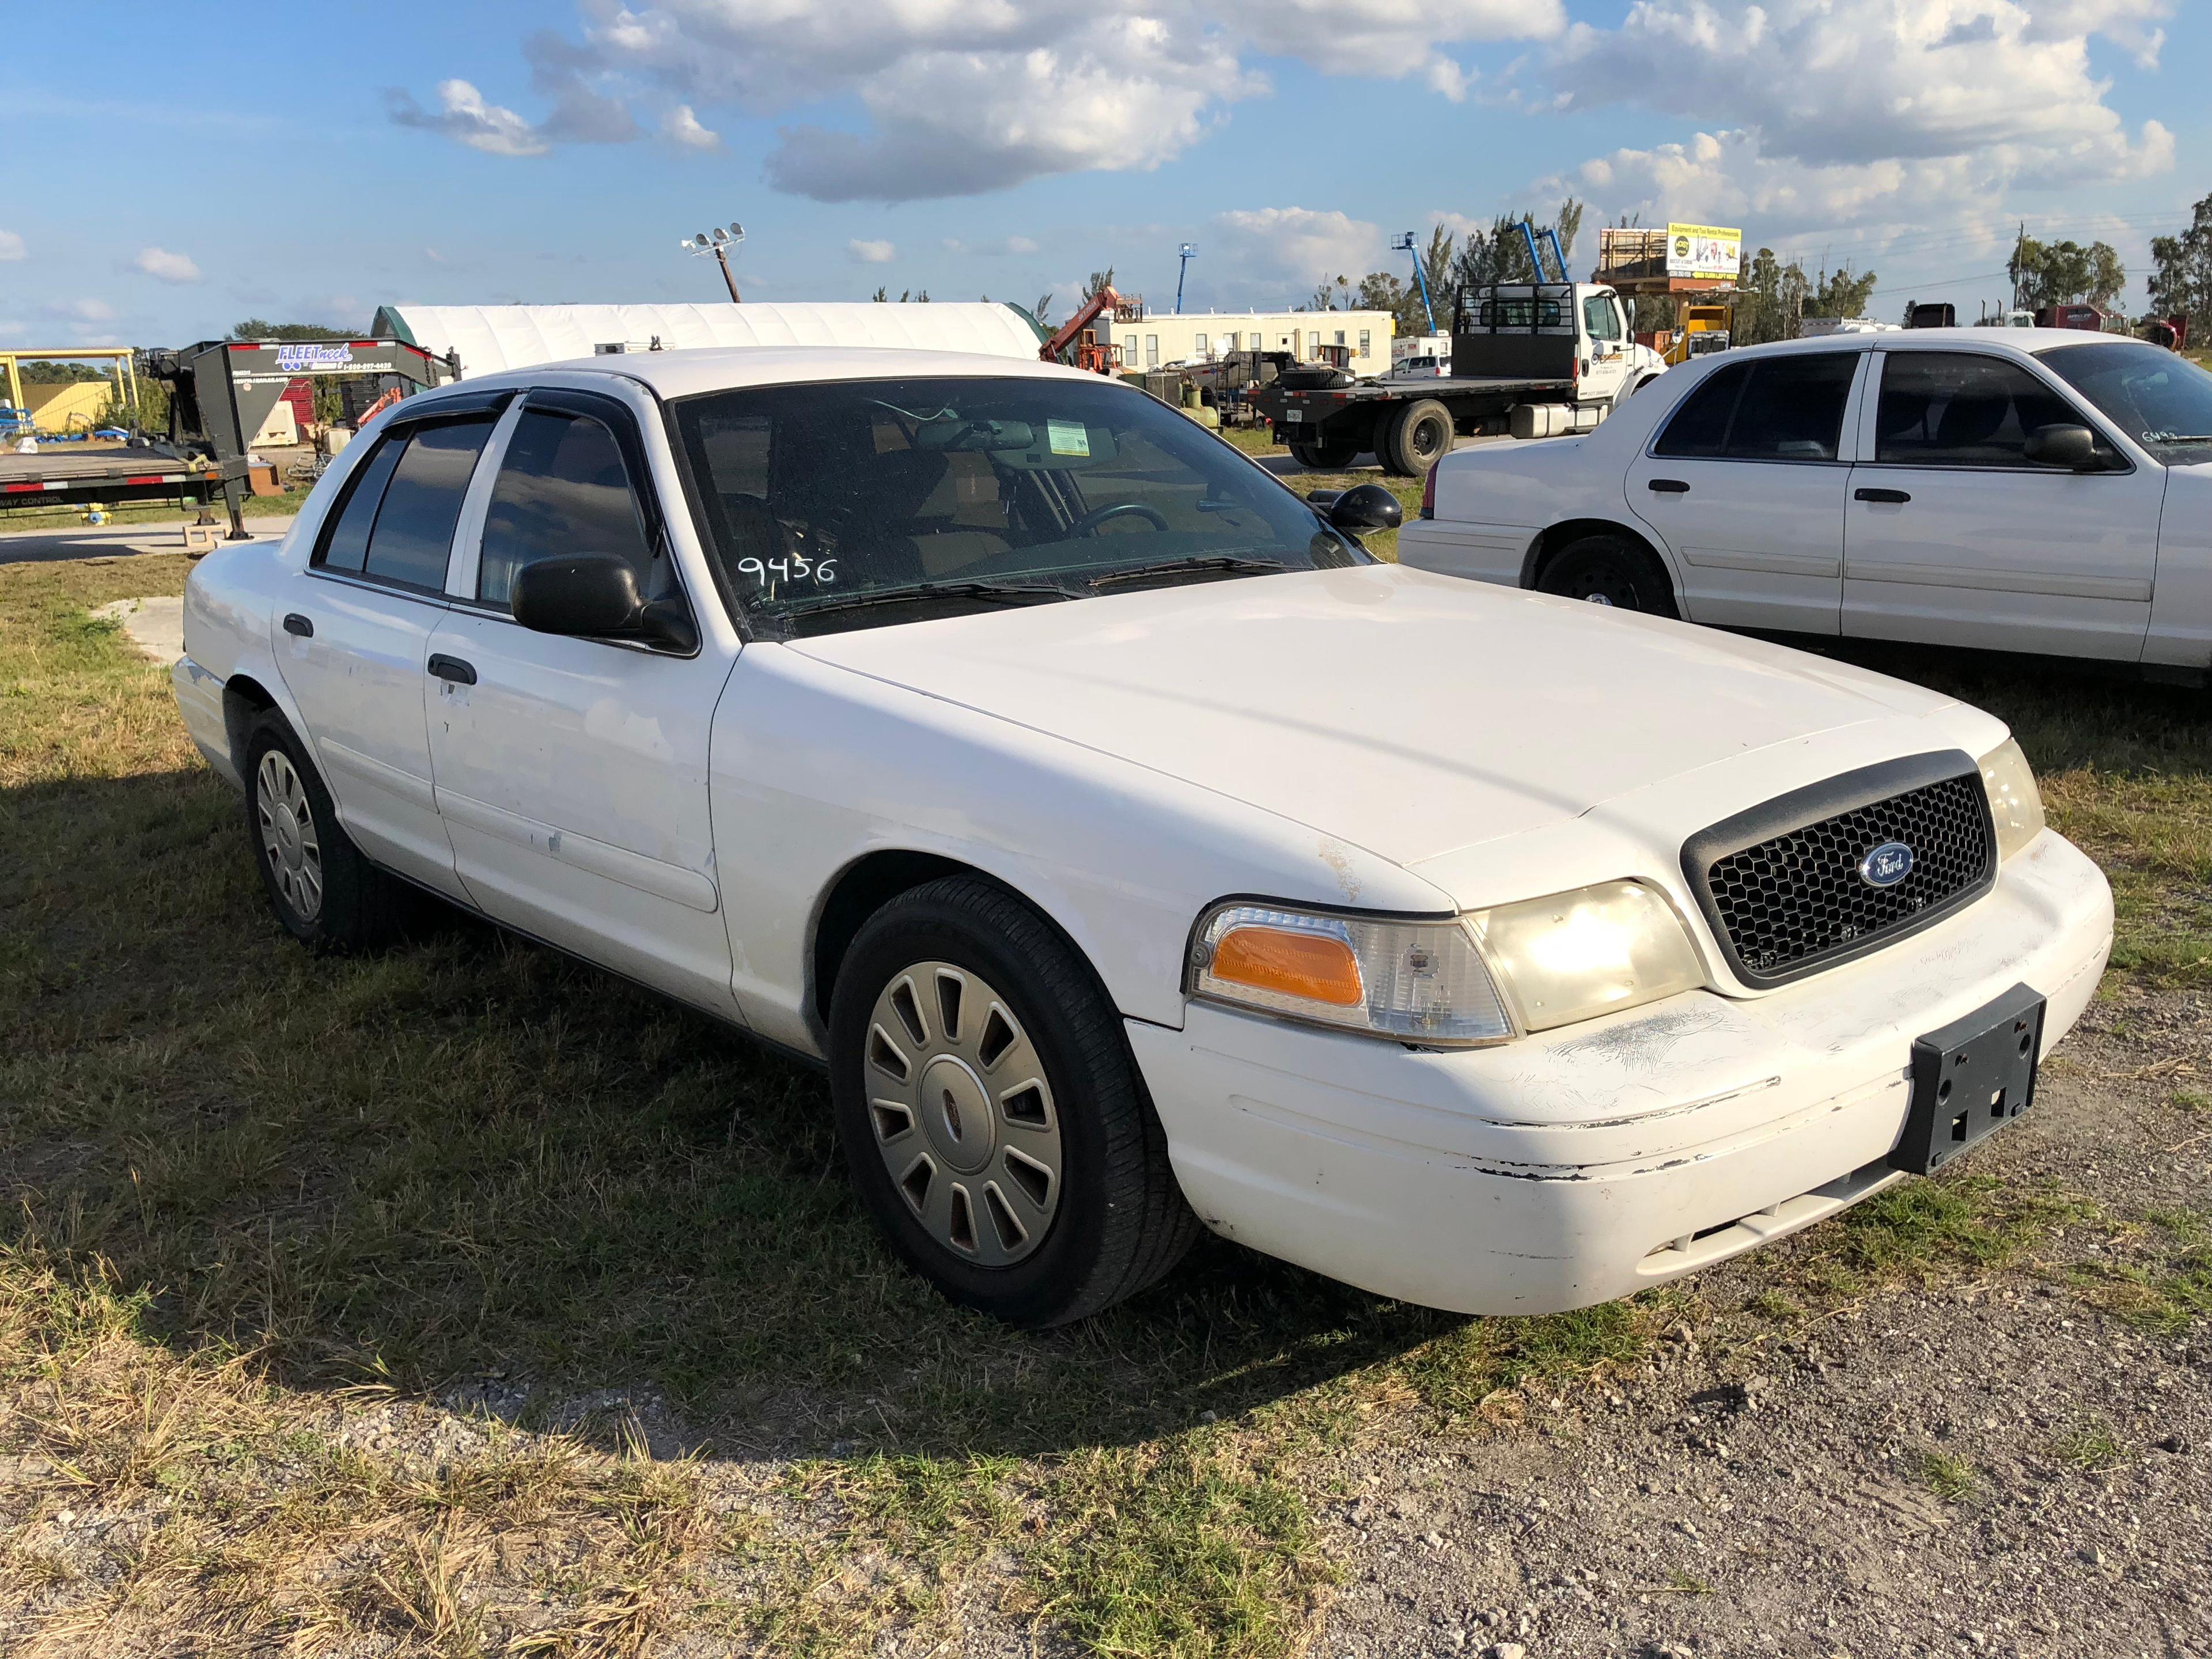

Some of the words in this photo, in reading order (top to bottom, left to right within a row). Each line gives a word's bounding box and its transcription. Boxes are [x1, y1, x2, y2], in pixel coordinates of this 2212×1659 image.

[21, 496, 63, 506] CONTROL
[738, 557, 838, 586] 9456
[1877, 851, 1904, 877] Ford
